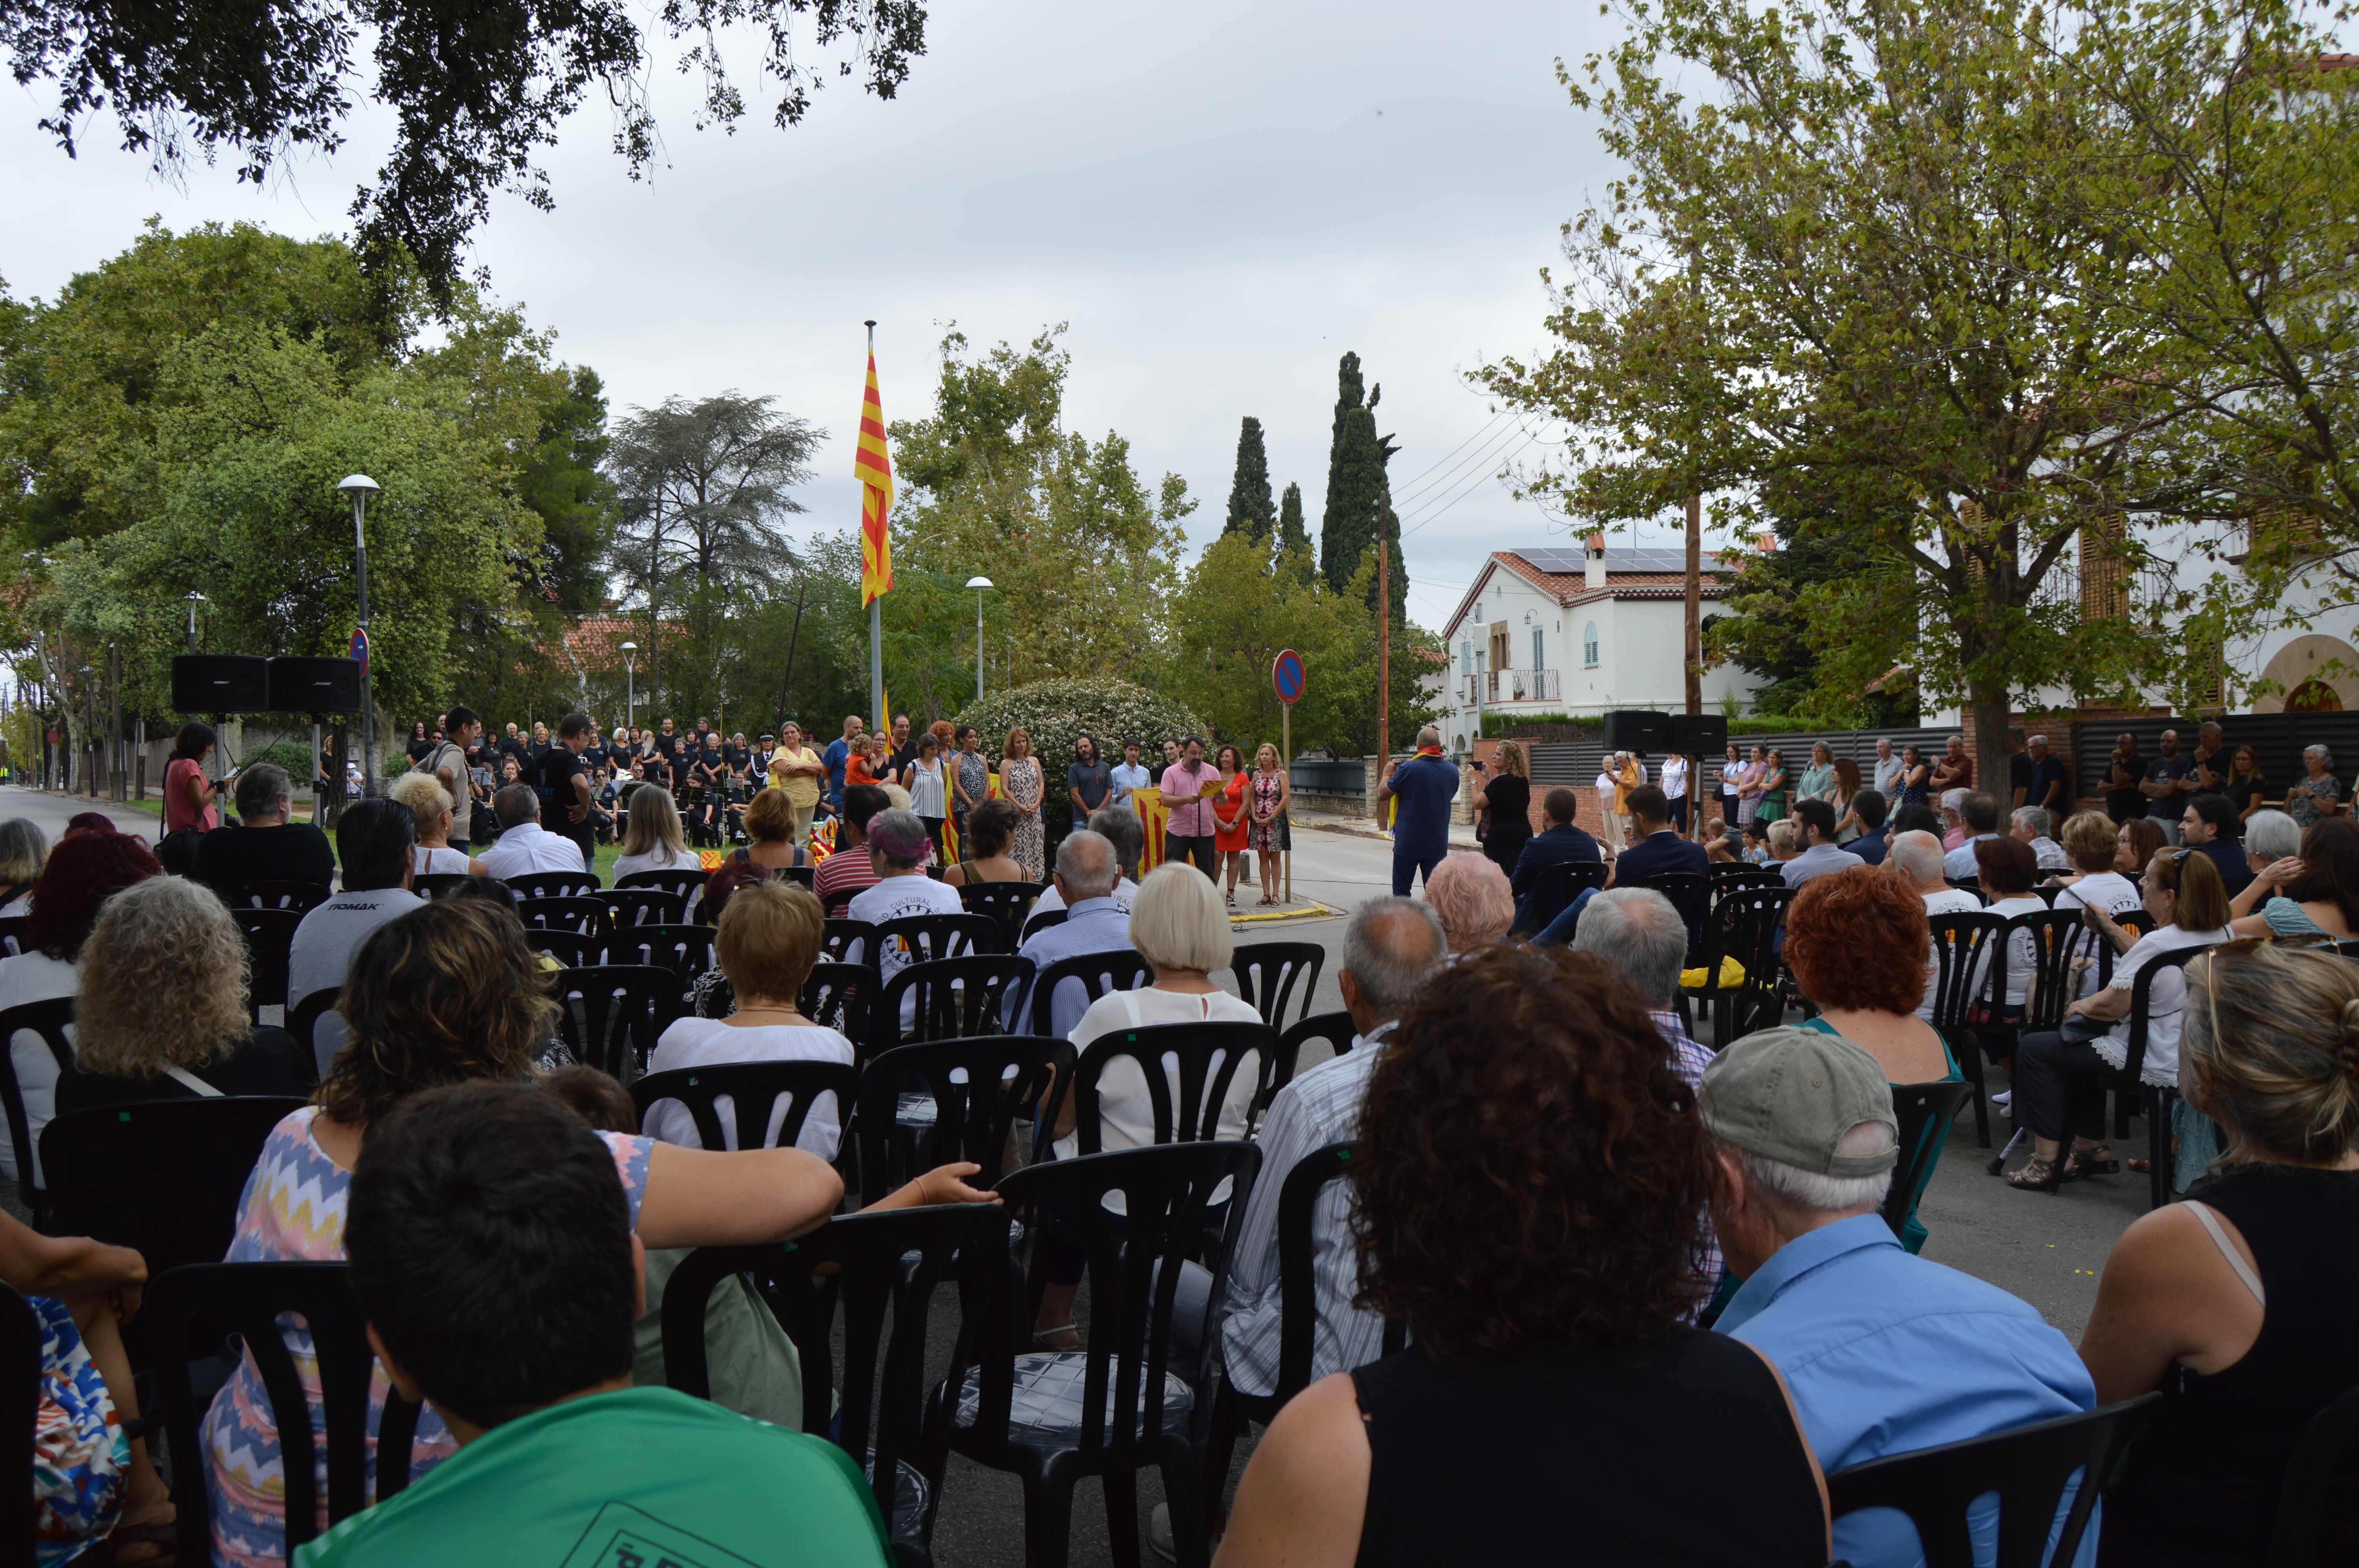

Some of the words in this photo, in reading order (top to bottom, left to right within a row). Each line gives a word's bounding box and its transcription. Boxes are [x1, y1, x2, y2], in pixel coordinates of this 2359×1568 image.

[891, 897, 931, 909] CULTURAL
[2107, 893, 2135, 905] CULTURAL
[1933, 902, 1970, 915] CULTURAL
